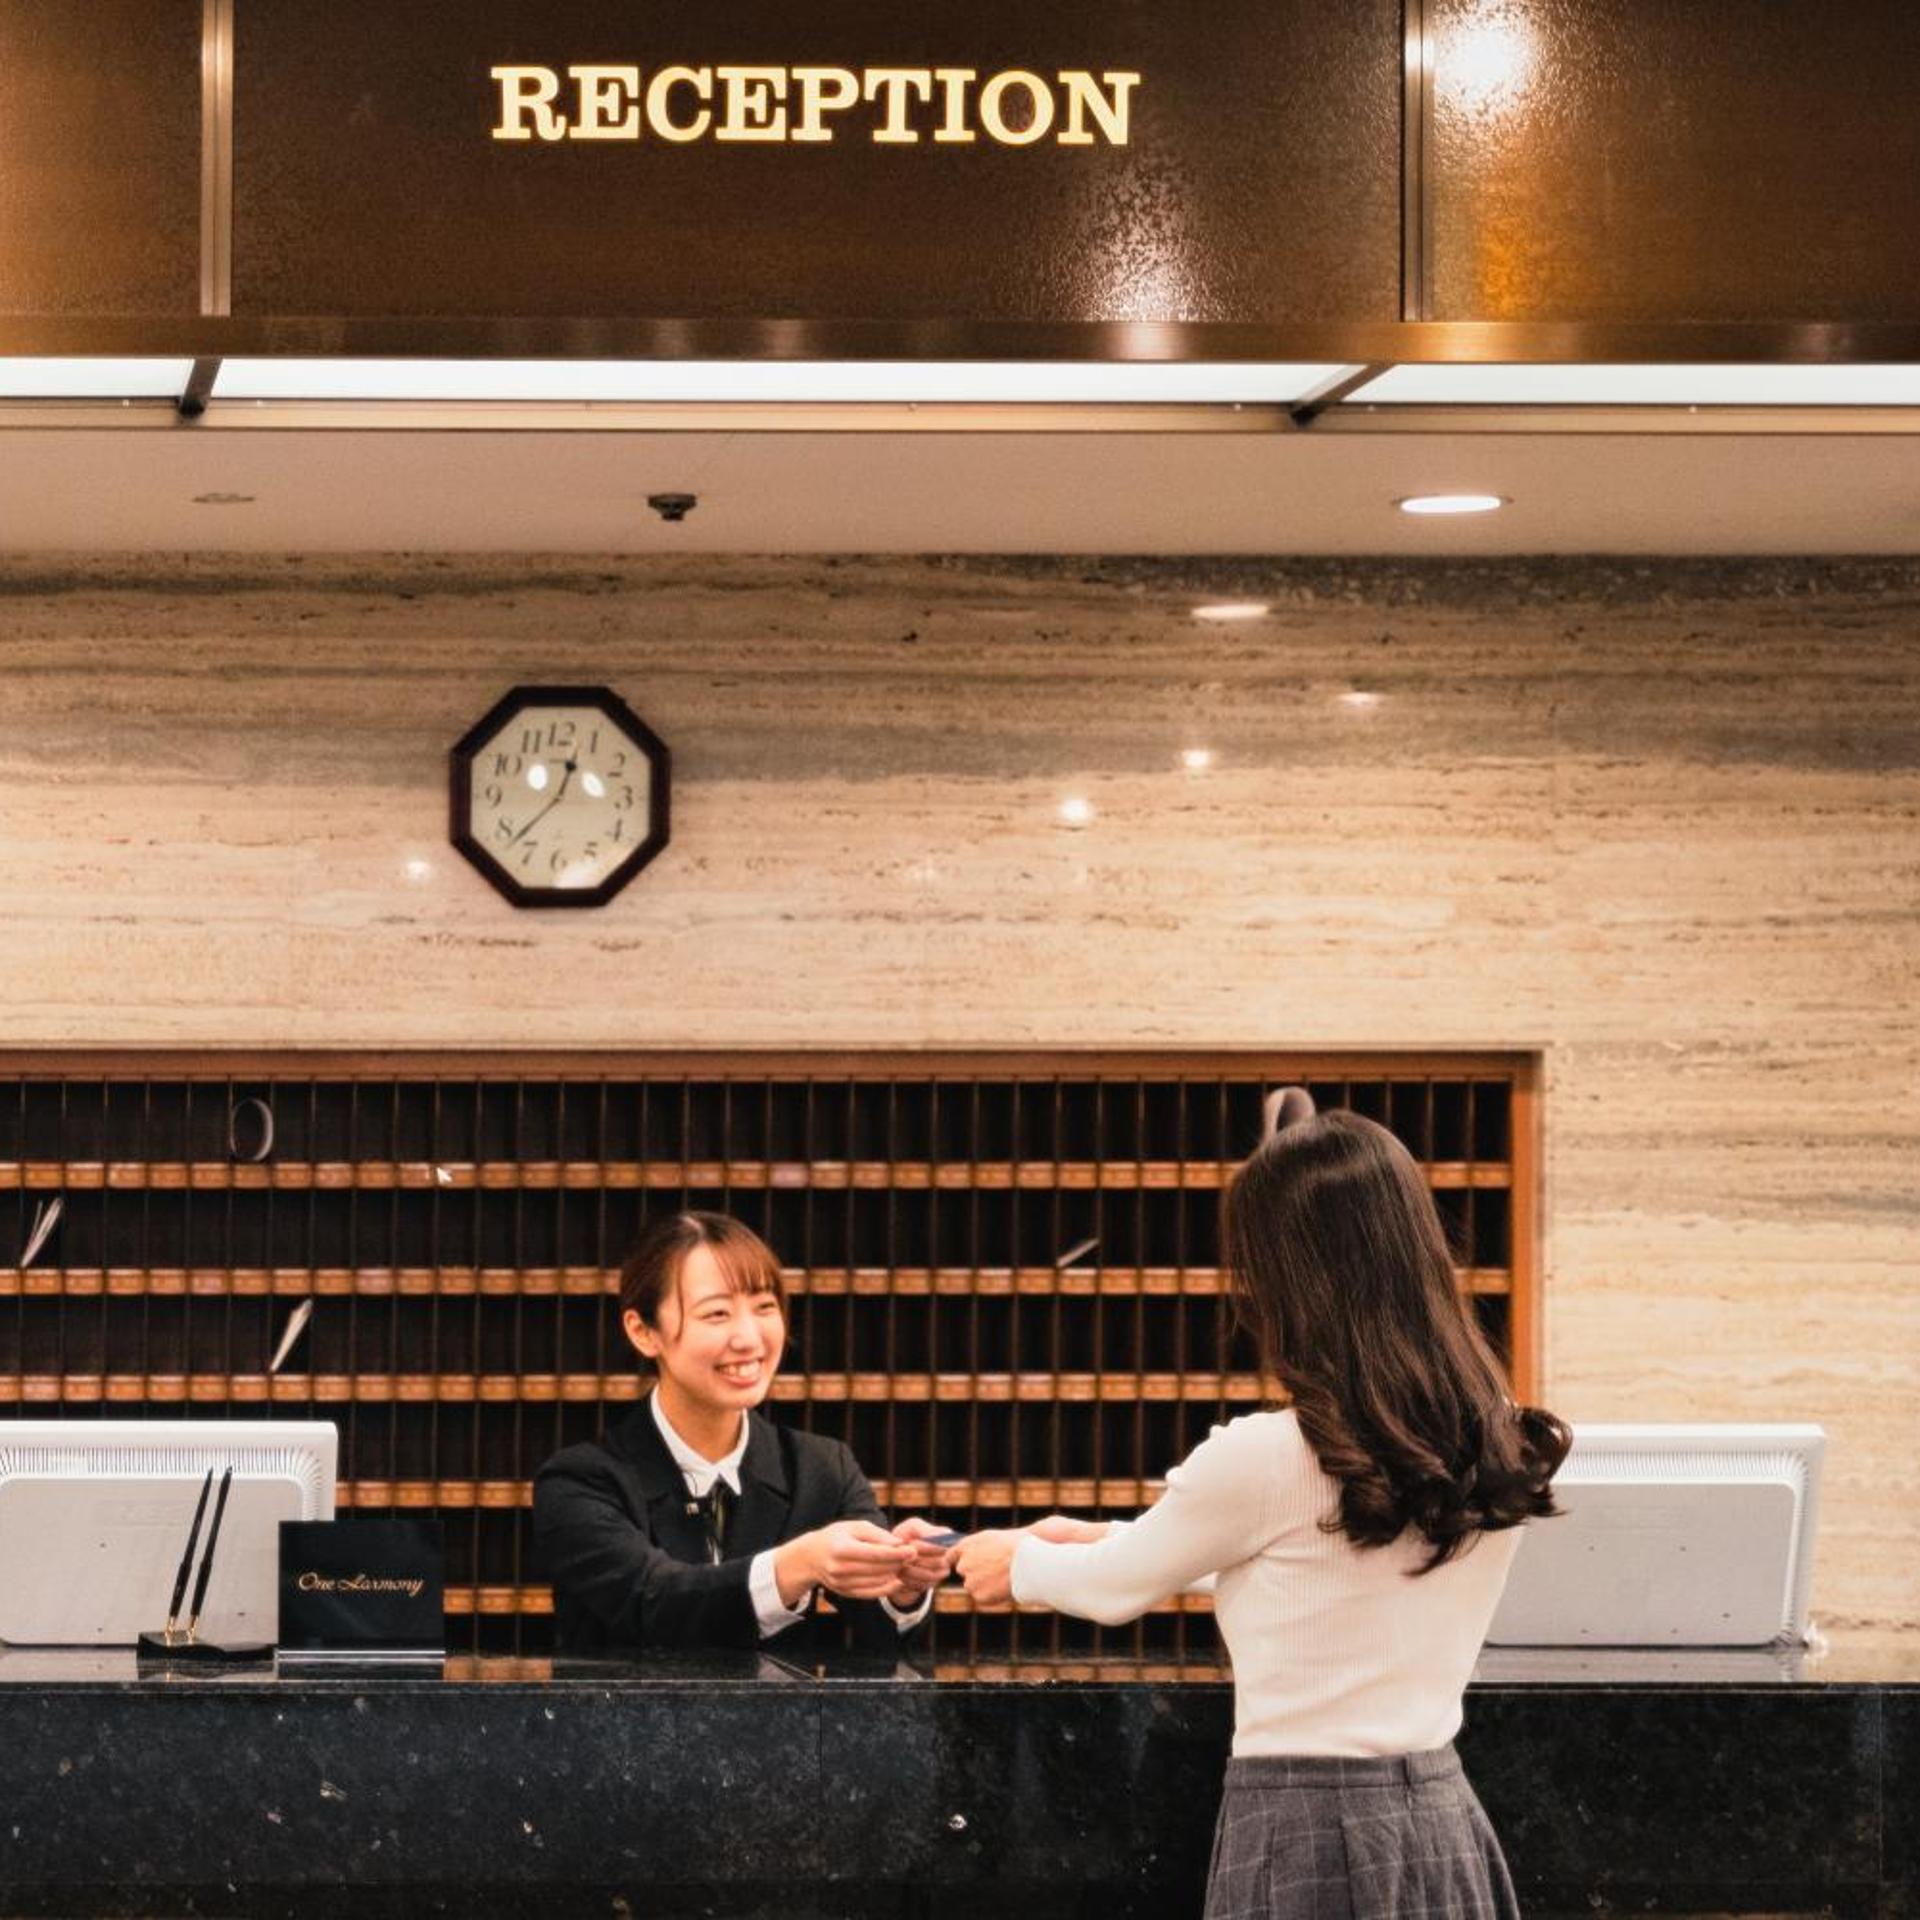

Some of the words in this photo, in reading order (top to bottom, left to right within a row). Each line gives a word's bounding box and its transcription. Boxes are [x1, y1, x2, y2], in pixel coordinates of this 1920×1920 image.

[490, 65, 1141, 145] RECEPTION
[521, 729, 542, 753] 11
[549, 721, 576, 747] 12
[590, 730, 598, 753] 1
[495, 752, 522, 777] 10
[607, 752, 626, 778] 2
[485, 784, 502, 809] 9
[613, 785, 633, 809] 3
[494, 816, 513, 839] 8
[606, 818, 622, 842] 4
[521, 841, 538, 865] 7
[550, 849, 568, 871] 6
[298, 1571, 335, 1591] One
[337, 1573, 424, 1598] Harmony
